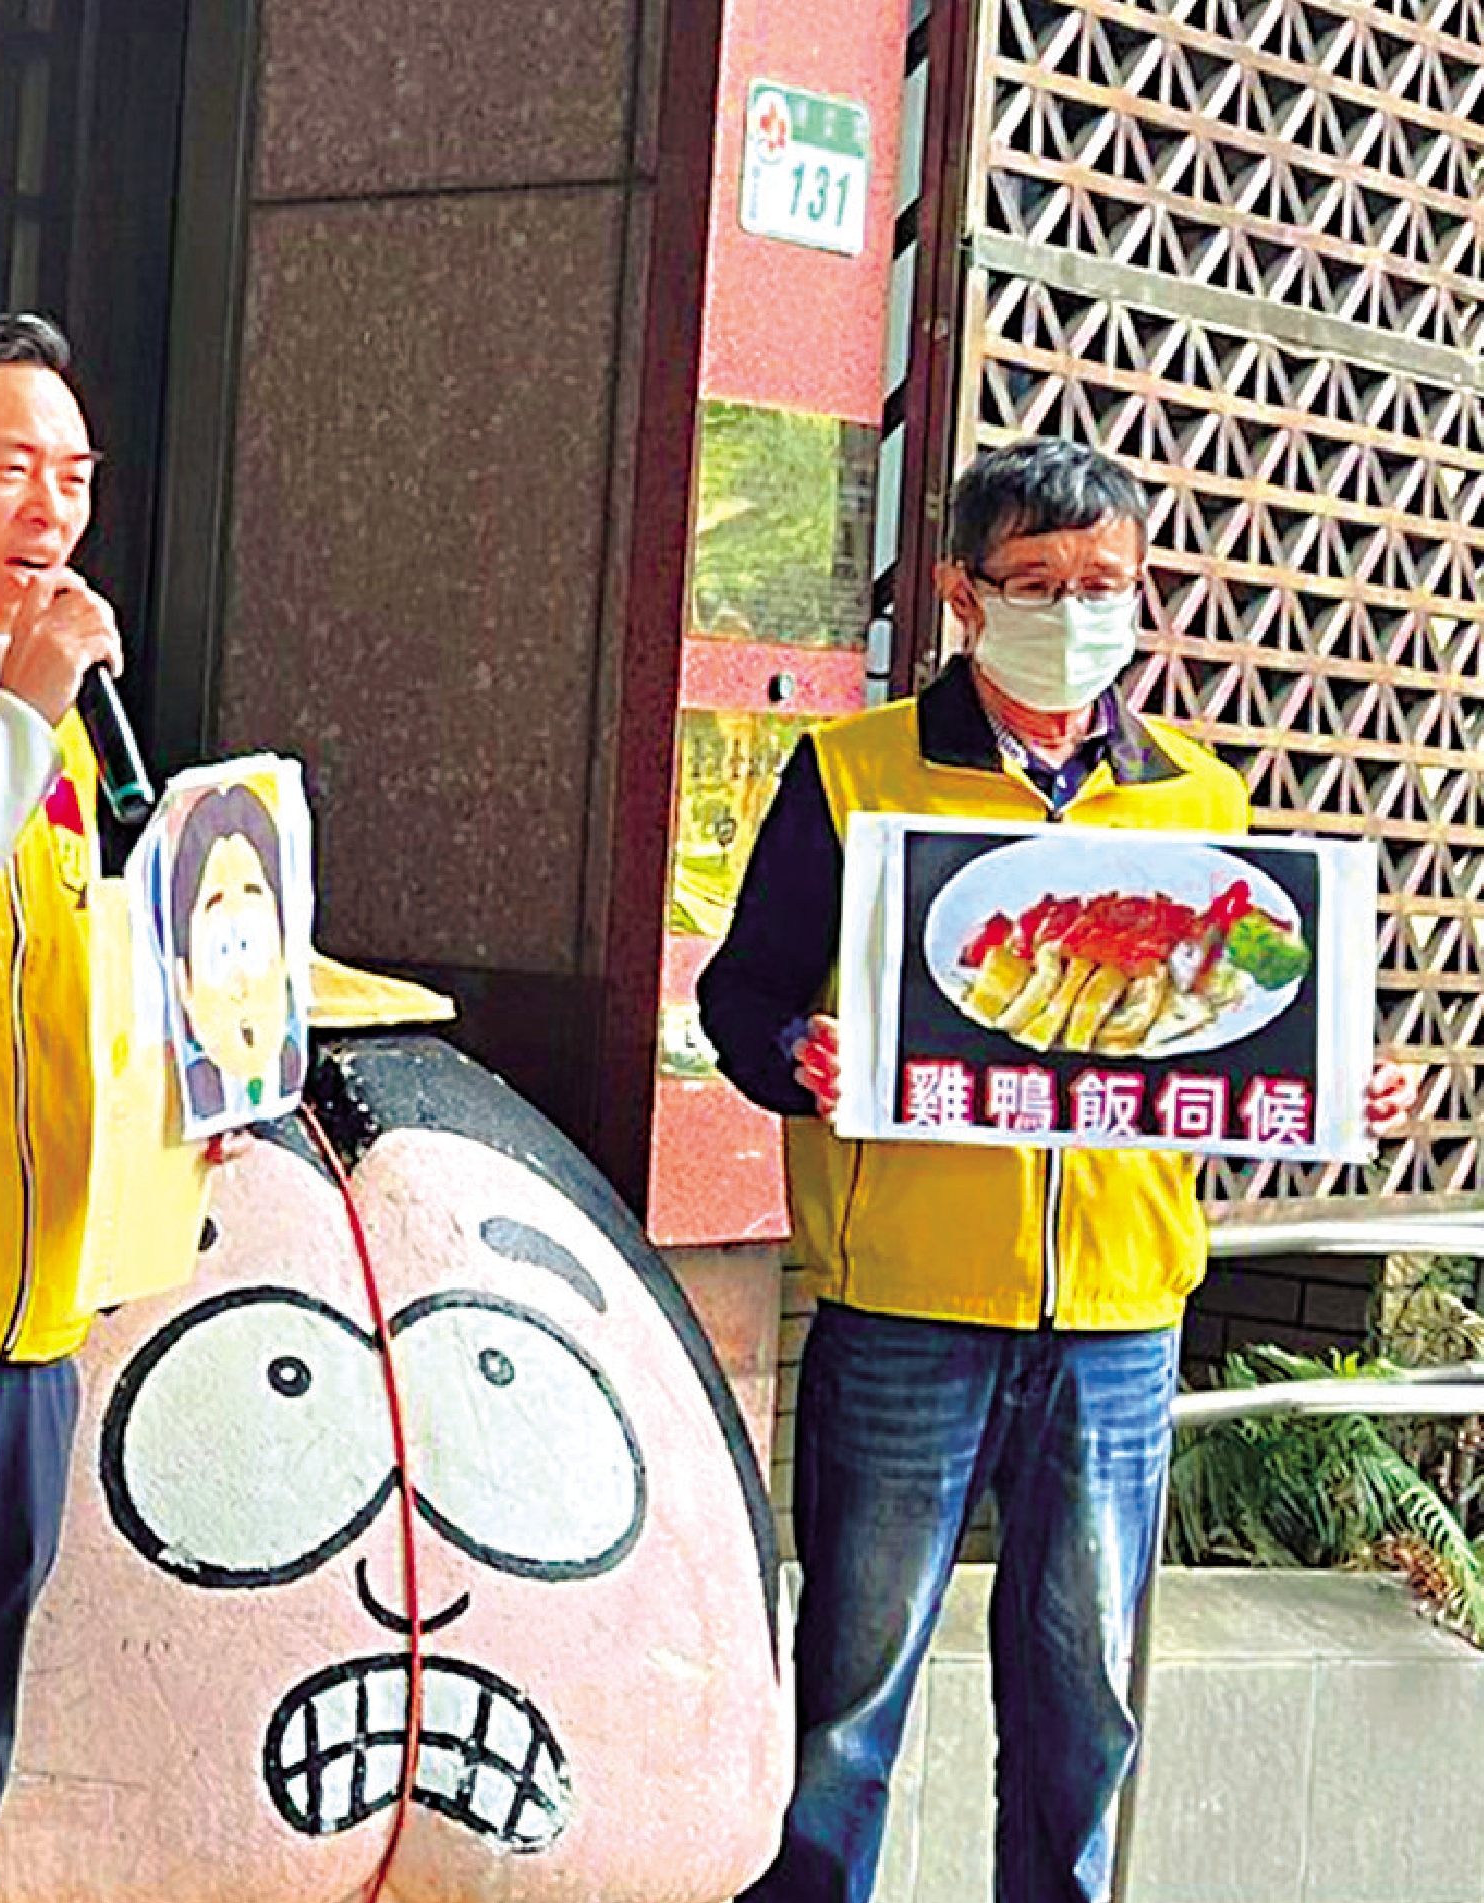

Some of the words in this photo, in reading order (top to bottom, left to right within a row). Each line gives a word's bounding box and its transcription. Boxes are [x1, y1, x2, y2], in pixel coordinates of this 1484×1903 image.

[789, 161, 851, 228] 131
[900, 1058, 1314, 1148] 雞鴨飯伺候
